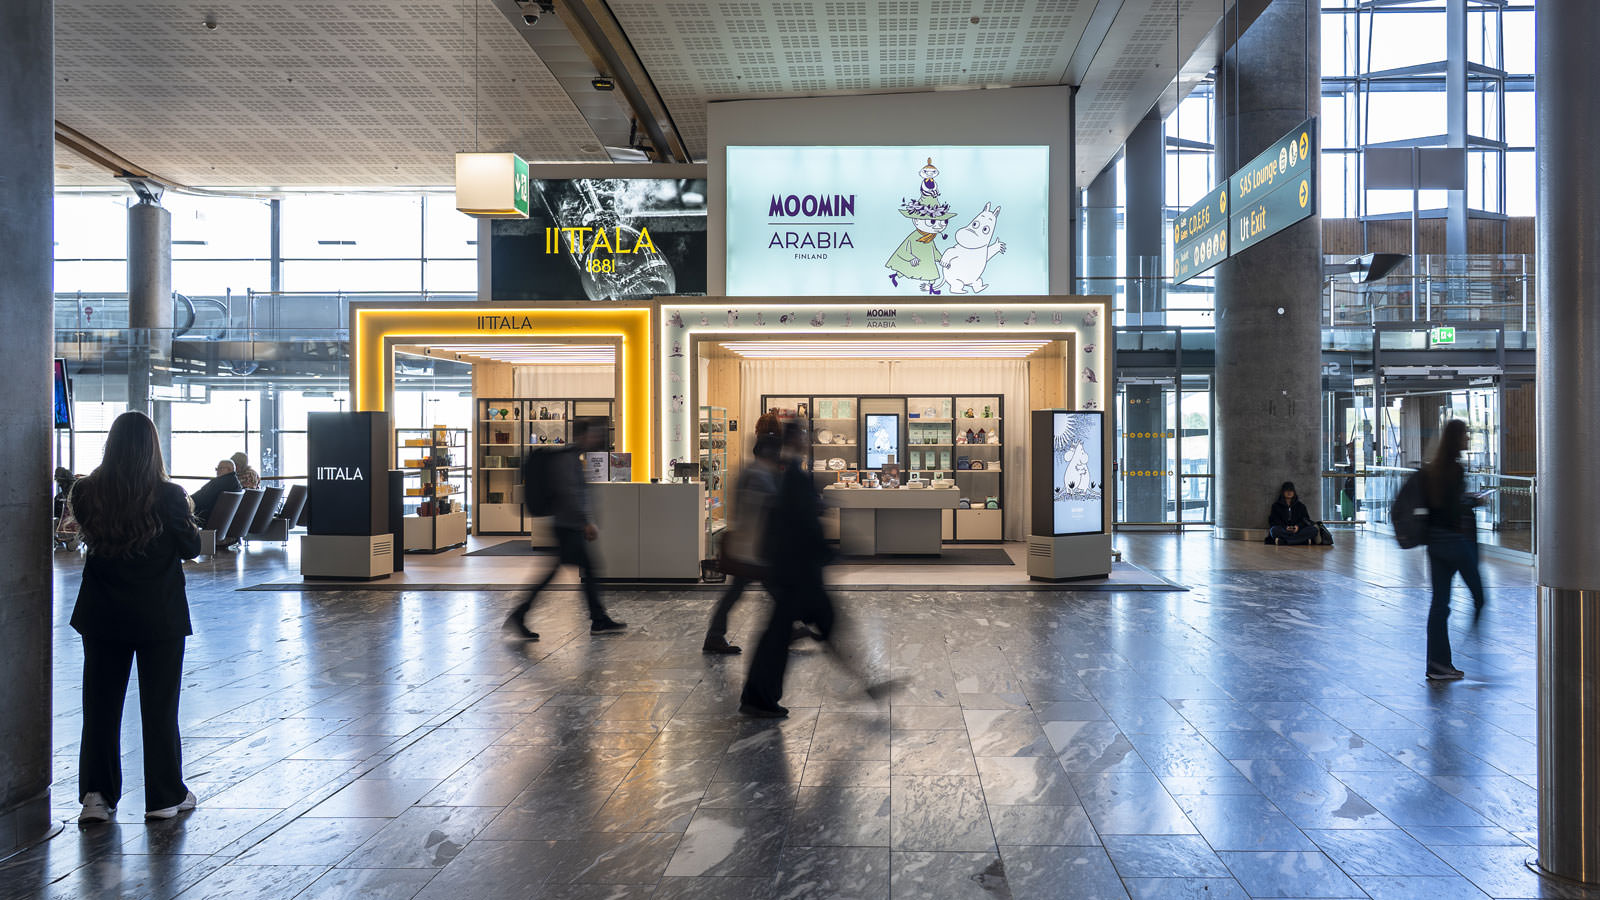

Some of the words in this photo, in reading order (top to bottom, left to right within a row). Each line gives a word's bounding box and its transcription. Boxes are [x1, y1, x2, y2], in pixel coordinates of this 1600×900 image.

[1240, 172, 1251, 198] SAS
[1253, 160, 1277, 189] Lounge
[768, 193, 855, 217] MOOMIN
[1240, 216, 1249, 242] Ut
[1251, 205, 1266, 236] Exit
[545, 227, 657, 254] IITTALA
[768, 232, 854, 249] ARABIA
[587, 258, 615, 273] 1881
[866, 309, 897, 318] MOOMIN
[477, 315, 533, 330] IITTALA
[866, 321, 897, 329] ARABIA
[317, 466, 364, 481] IITTALA
